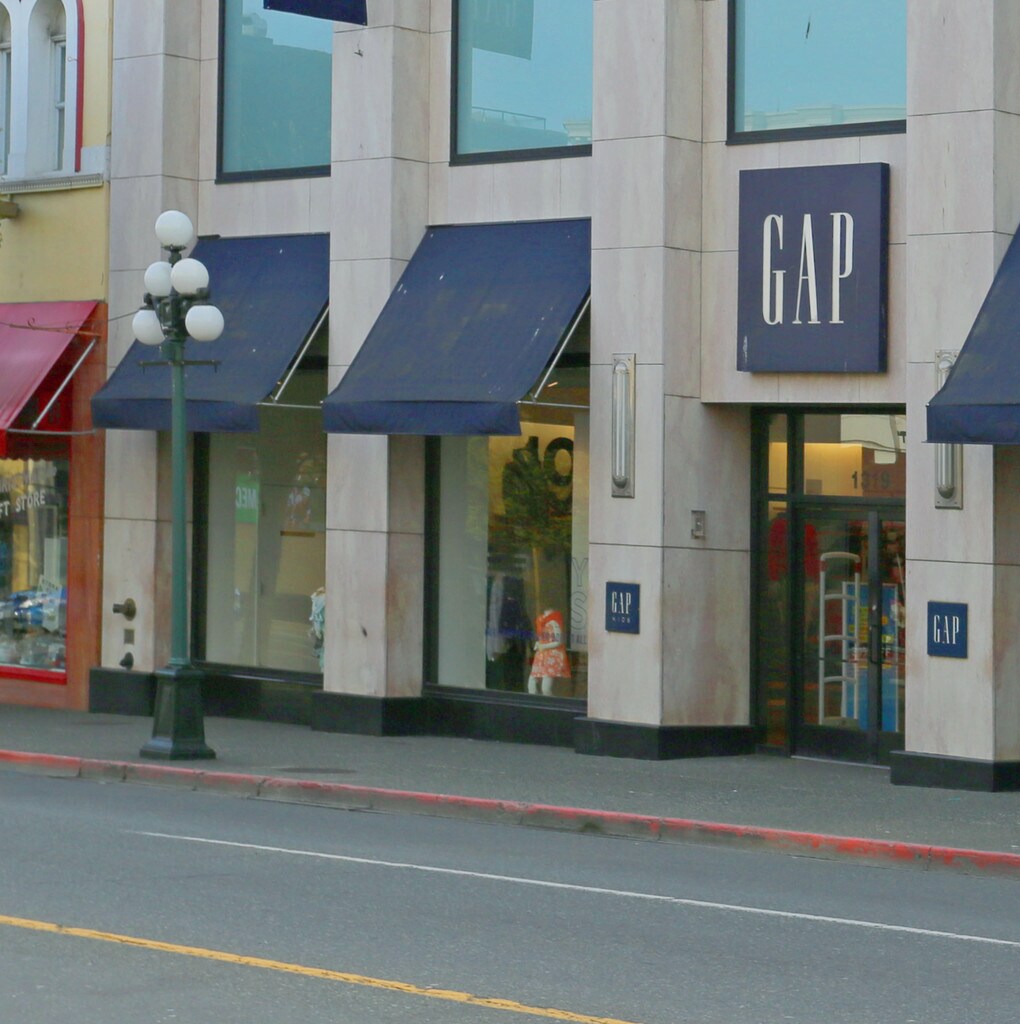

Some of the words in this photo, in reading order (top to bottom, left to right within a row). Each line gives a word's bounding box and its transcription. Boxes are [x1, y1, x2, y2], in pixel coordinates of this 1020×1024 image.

[761, 211, 855, 325] GAP
[15, 488, 46, 513] STORE
[611, 591, 632, 614] GAP
[933, 614, 959, 645] GAP
